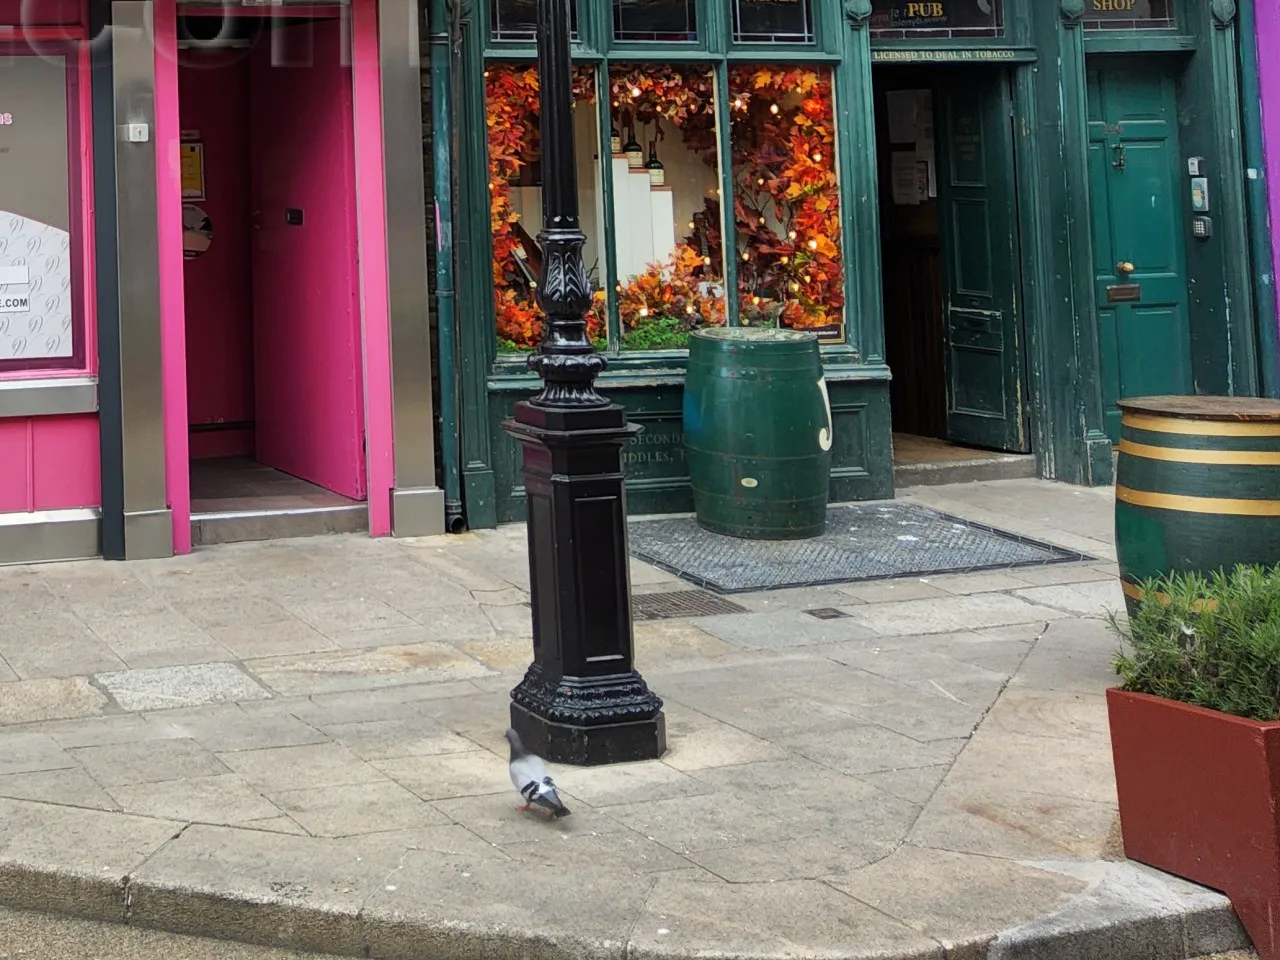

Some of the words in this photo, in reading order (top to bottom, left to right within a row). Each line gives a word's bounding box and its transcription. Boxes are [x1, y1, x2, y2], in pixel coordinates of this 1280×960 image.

[906, 2, 944, 17] PUB
[874, 50, 918, 60] LICENSED
[920, 51, 933, 60] TO
[935, 50, 959, 60] DEAL
[961, 50, 972, 60] IN
[975, 50, 1015, 60] TOBACCO
[623, 451, 674, 463] IDDLES,
